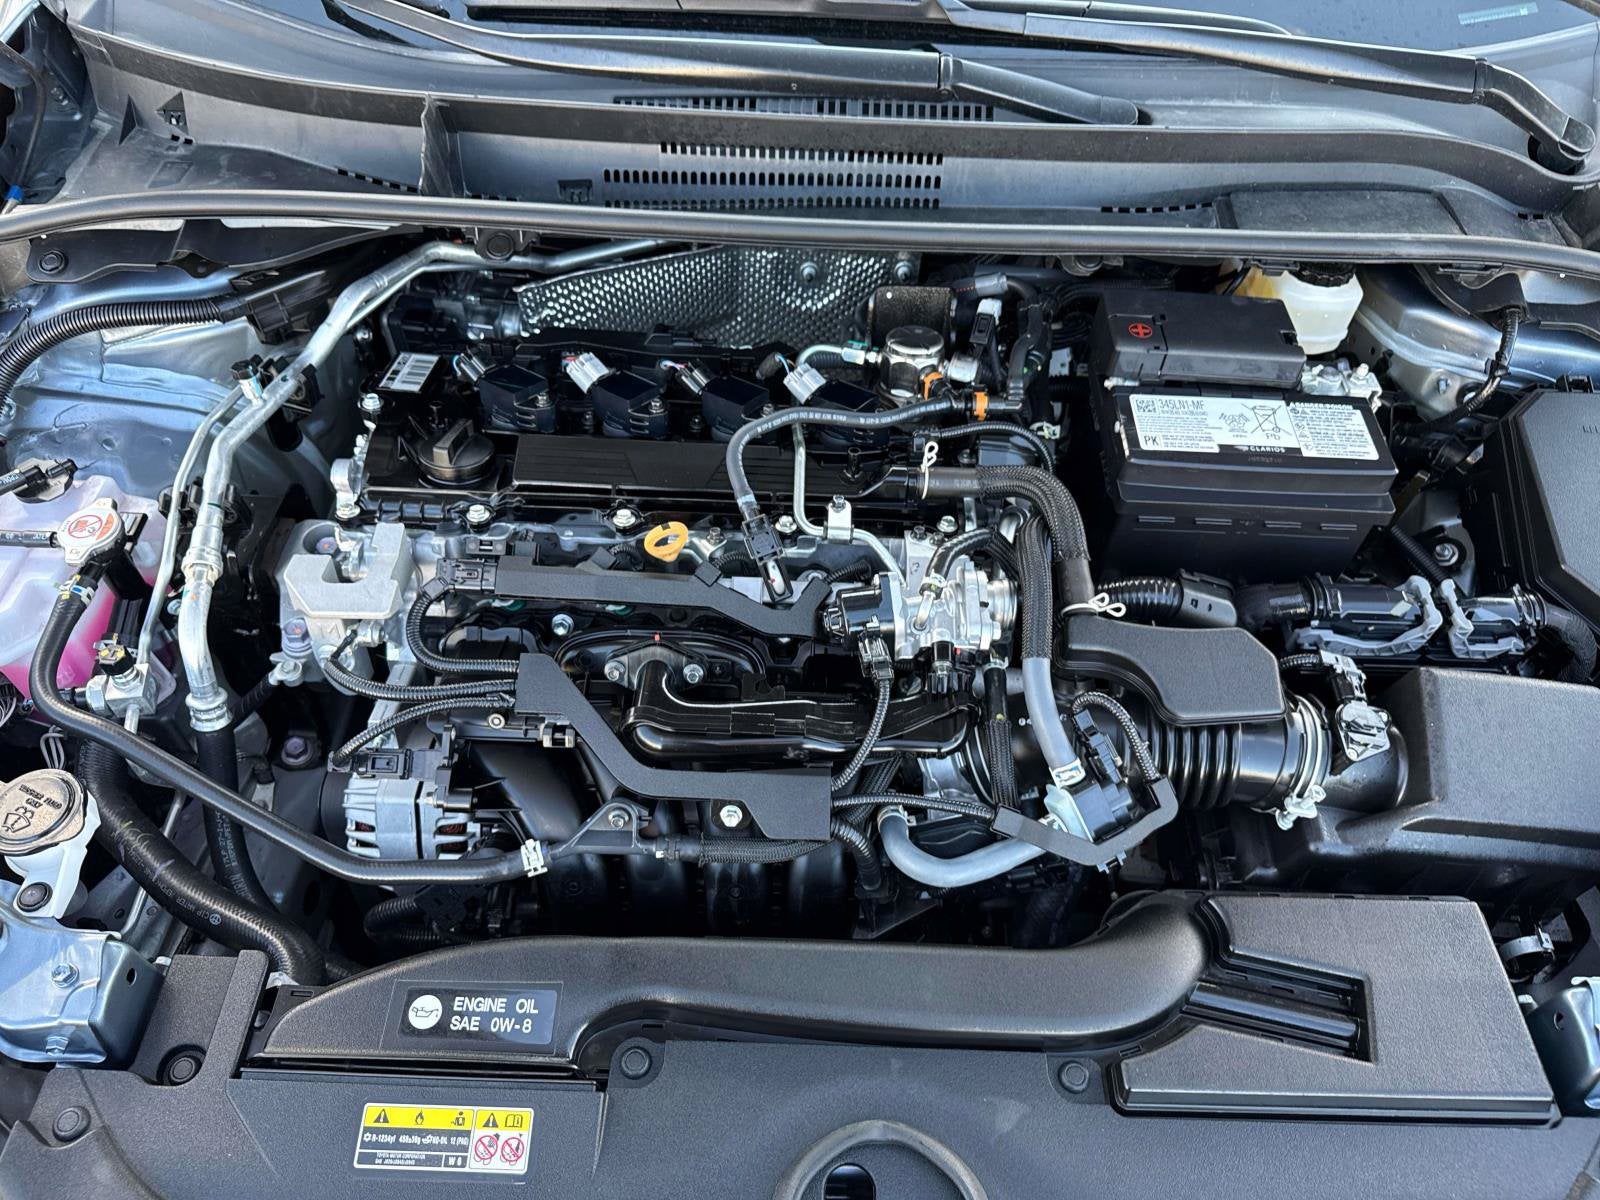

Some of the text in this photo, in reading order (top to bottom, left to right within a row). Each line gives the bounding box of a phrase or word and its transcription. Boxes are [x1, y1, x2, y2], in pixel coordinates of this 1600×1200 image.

[1159, 398, 1205, 410] 345LN1-MF
[1143, 435, 1159, 446] PK
[1249, 445, 1286, 454] CLARIOS
[452, 996, 539, 1015] ENGINE OIL
[449, 1015, 532, 1034] SAE 0W-8
[448, 1156, 456, 1166] W
